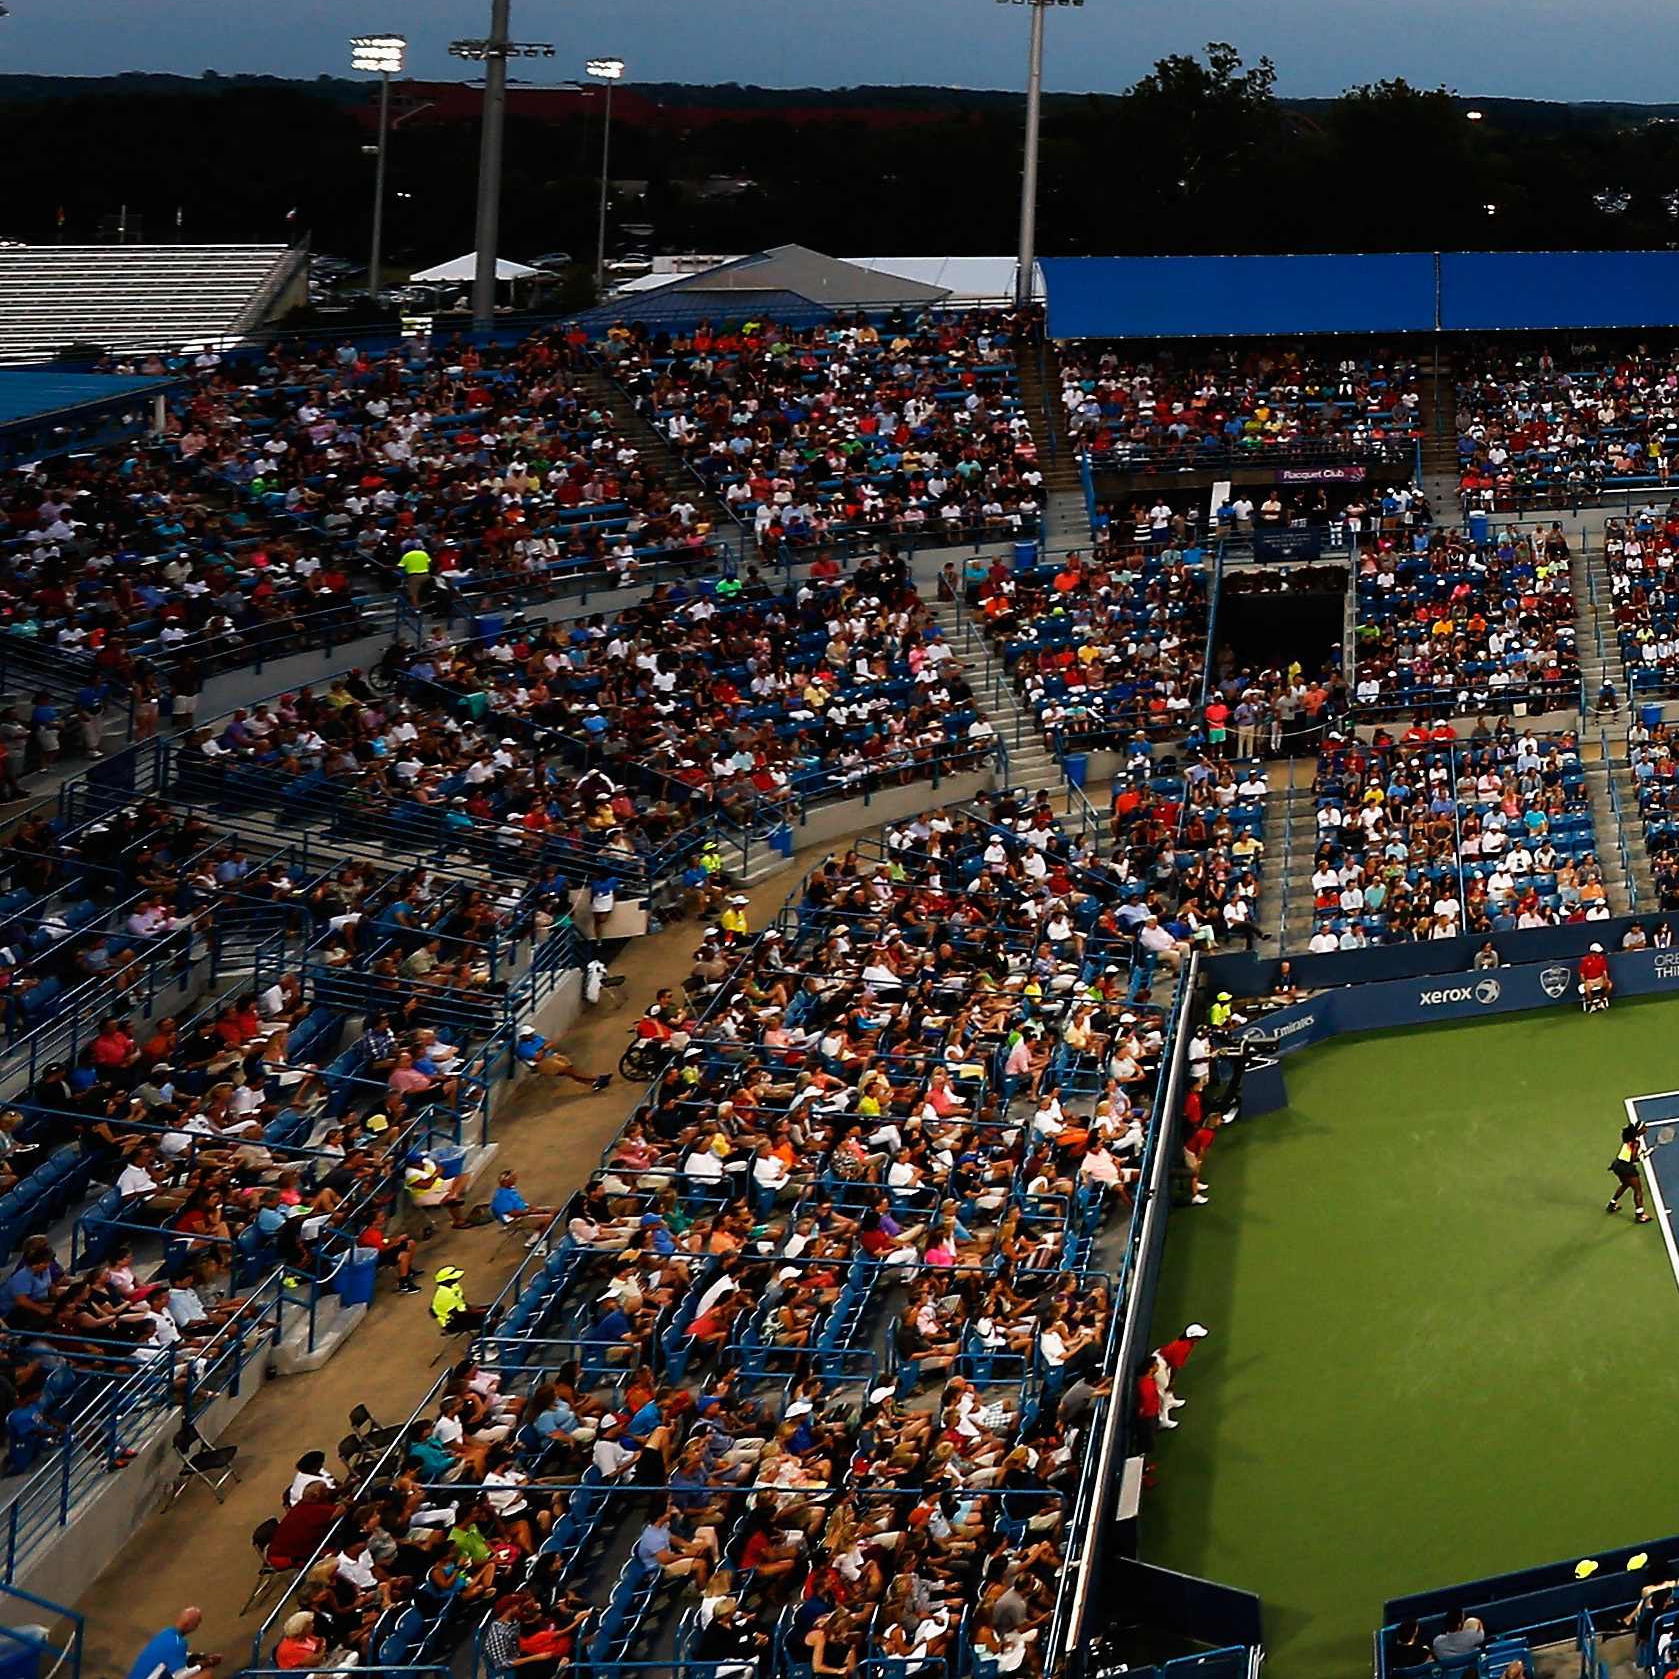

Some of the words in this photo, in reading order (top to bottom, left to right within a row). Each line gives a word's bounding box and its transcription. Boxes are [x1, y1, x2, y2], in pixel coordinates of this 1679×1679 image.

[1283, 470, 1321, 480] Racquet
[1323, 469, 1345, 478] Club
[1420, 986, 1473, 1006] xerox
[1272, 1015, 1315, 1038] Emirates
